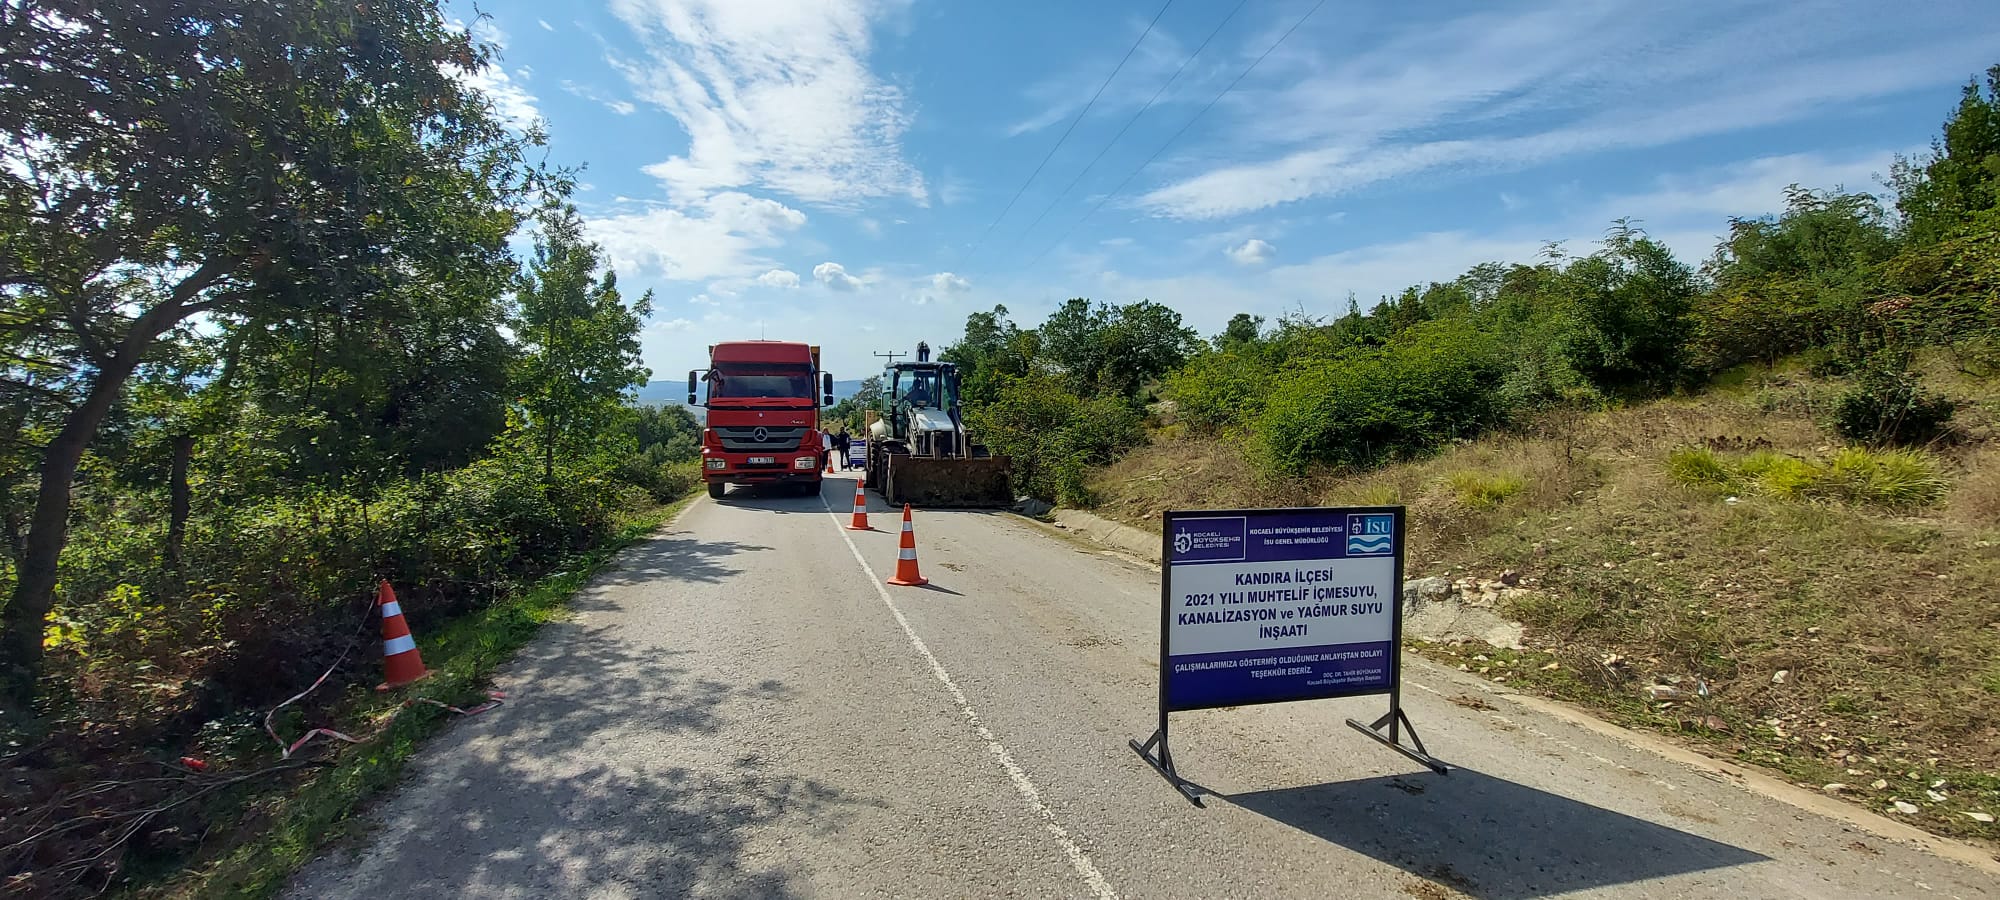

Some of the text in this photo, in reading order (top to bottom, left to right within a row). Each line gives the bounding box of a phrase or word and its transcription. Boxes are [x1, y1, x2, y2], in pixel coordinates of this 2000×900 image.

[1312, 525, 1343, 533] BELEDİYESİ
[1367, 518, 1391, 534] İSU
[1235, 567, 1333, 586] KANDIRA İLÇESİ
[1185, 585, 1377, 607] 2021 YILI MUHTELİF İÇMESUYU,
[1178, 602, 1383, 625] KANALİZASYON ve YAĞMUR SUYU
[1259, 624, 1307, 640] İNŞAATI
[1174, 649, 1383, 673] ÇALIŞMALARIMIZA GÖSTERMİŞ OLDUĞUNUZ ANLAYIŞTAN DOLAYI
[1251, 665, 1312, 679] TEŞEKKÜR EDERİZ.
